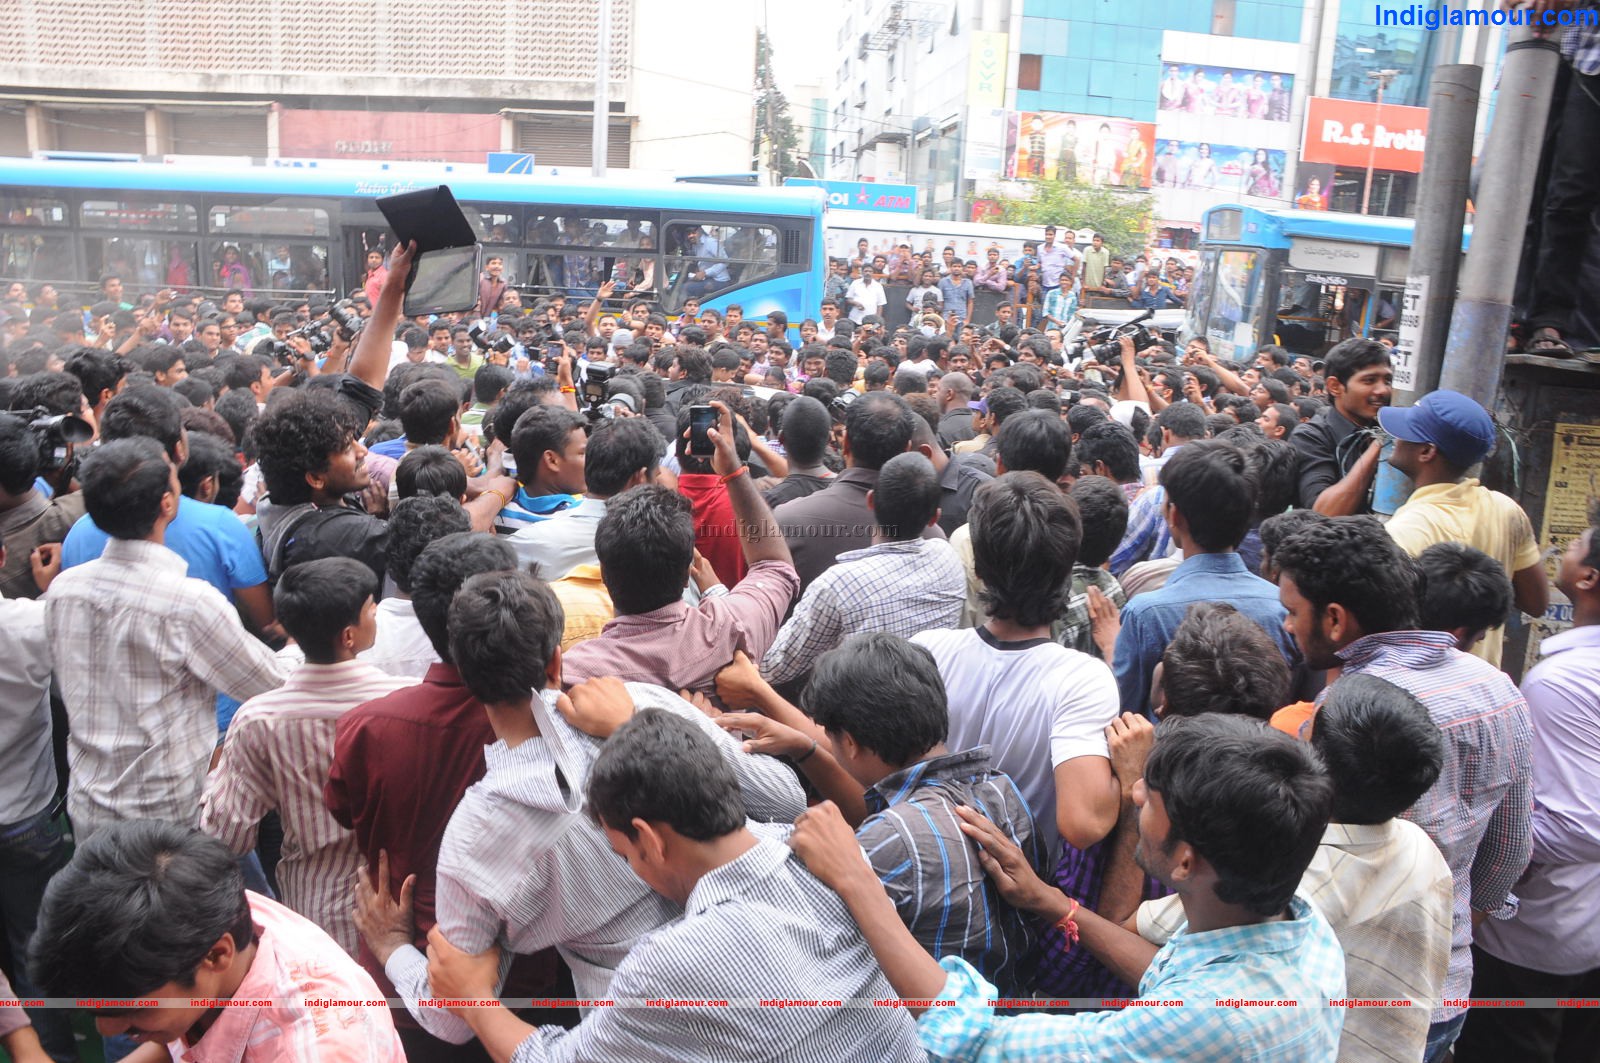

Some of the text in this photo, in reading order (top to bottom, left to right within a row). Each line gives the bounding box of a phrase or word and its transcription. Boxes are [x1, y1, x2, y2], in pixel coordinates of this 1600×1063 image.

[1321, 119, 1427, 152] R.S. Broth
[873, 195, 911, 209] ATM
